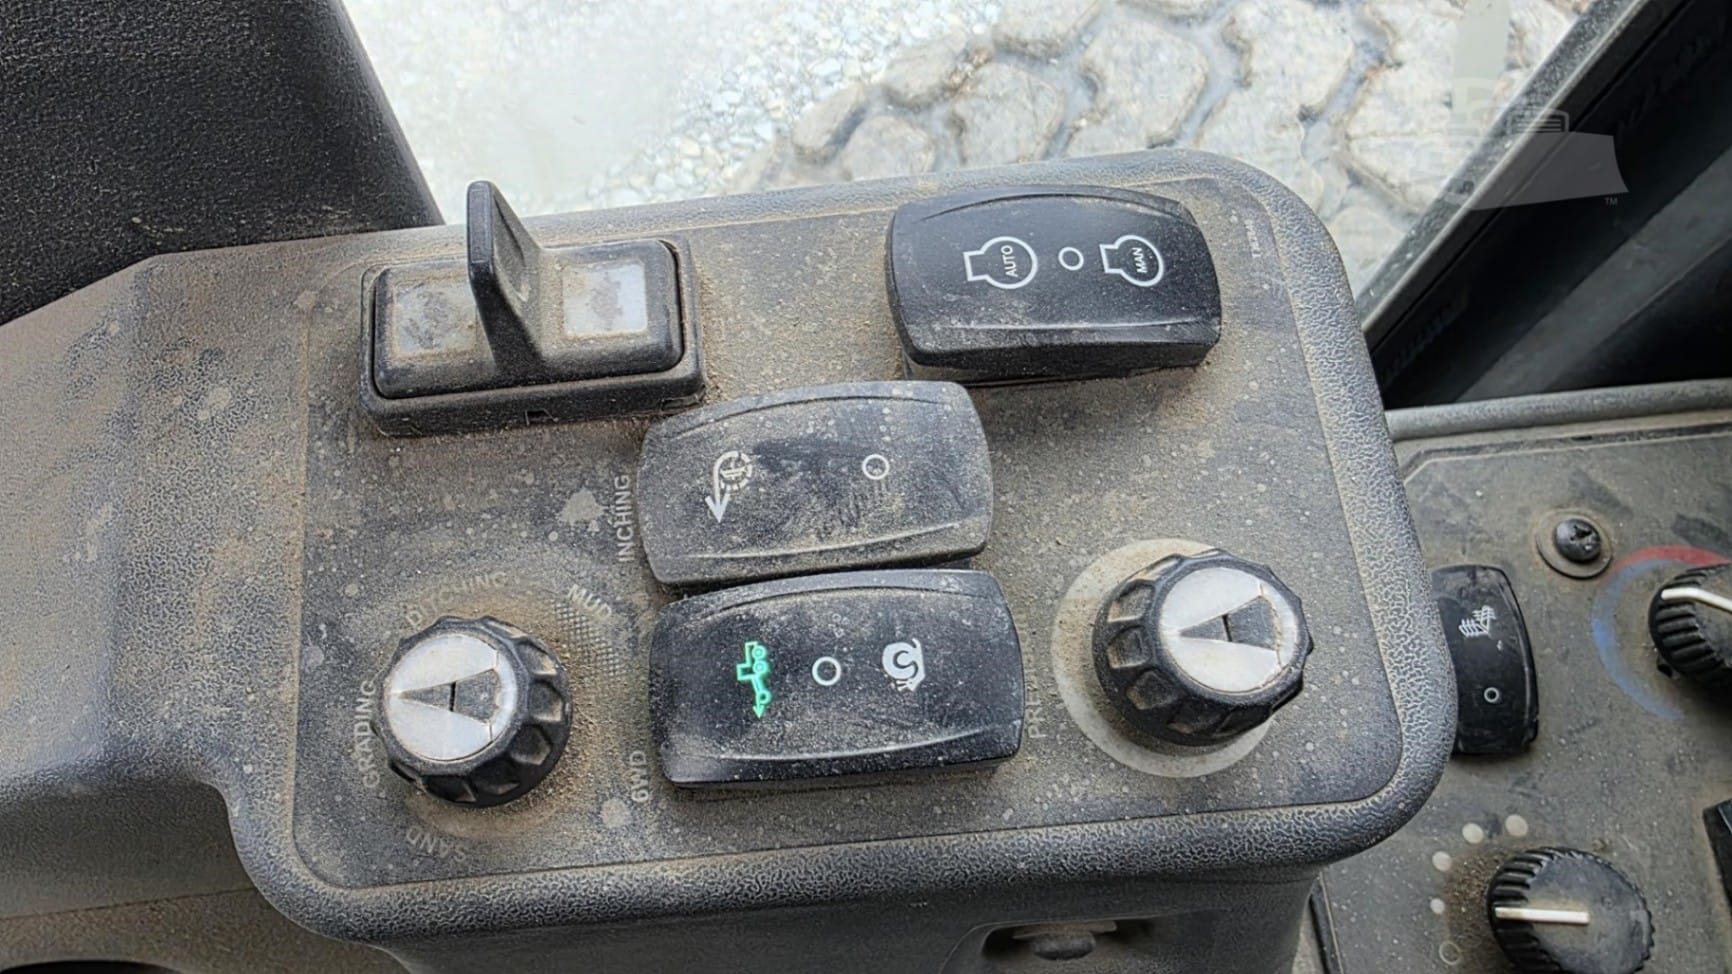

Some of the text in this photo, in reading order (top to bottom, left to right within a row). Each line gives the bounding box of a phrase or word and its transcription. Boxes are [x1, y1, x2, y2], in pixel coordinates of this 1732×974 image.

[1001, 244, 1018, 278] AUTO
[1132, 247, 1148, 273] MAN
[614, 474, 635, 563] INCHING
[405, 572, 508, 630] DITCHING
[566, 584, 613, 621] MUD
[354, 679, 380, 789] GRADING
[629, 750, 649, 803] 6WD
[405, 826, 469, 863] SAND
